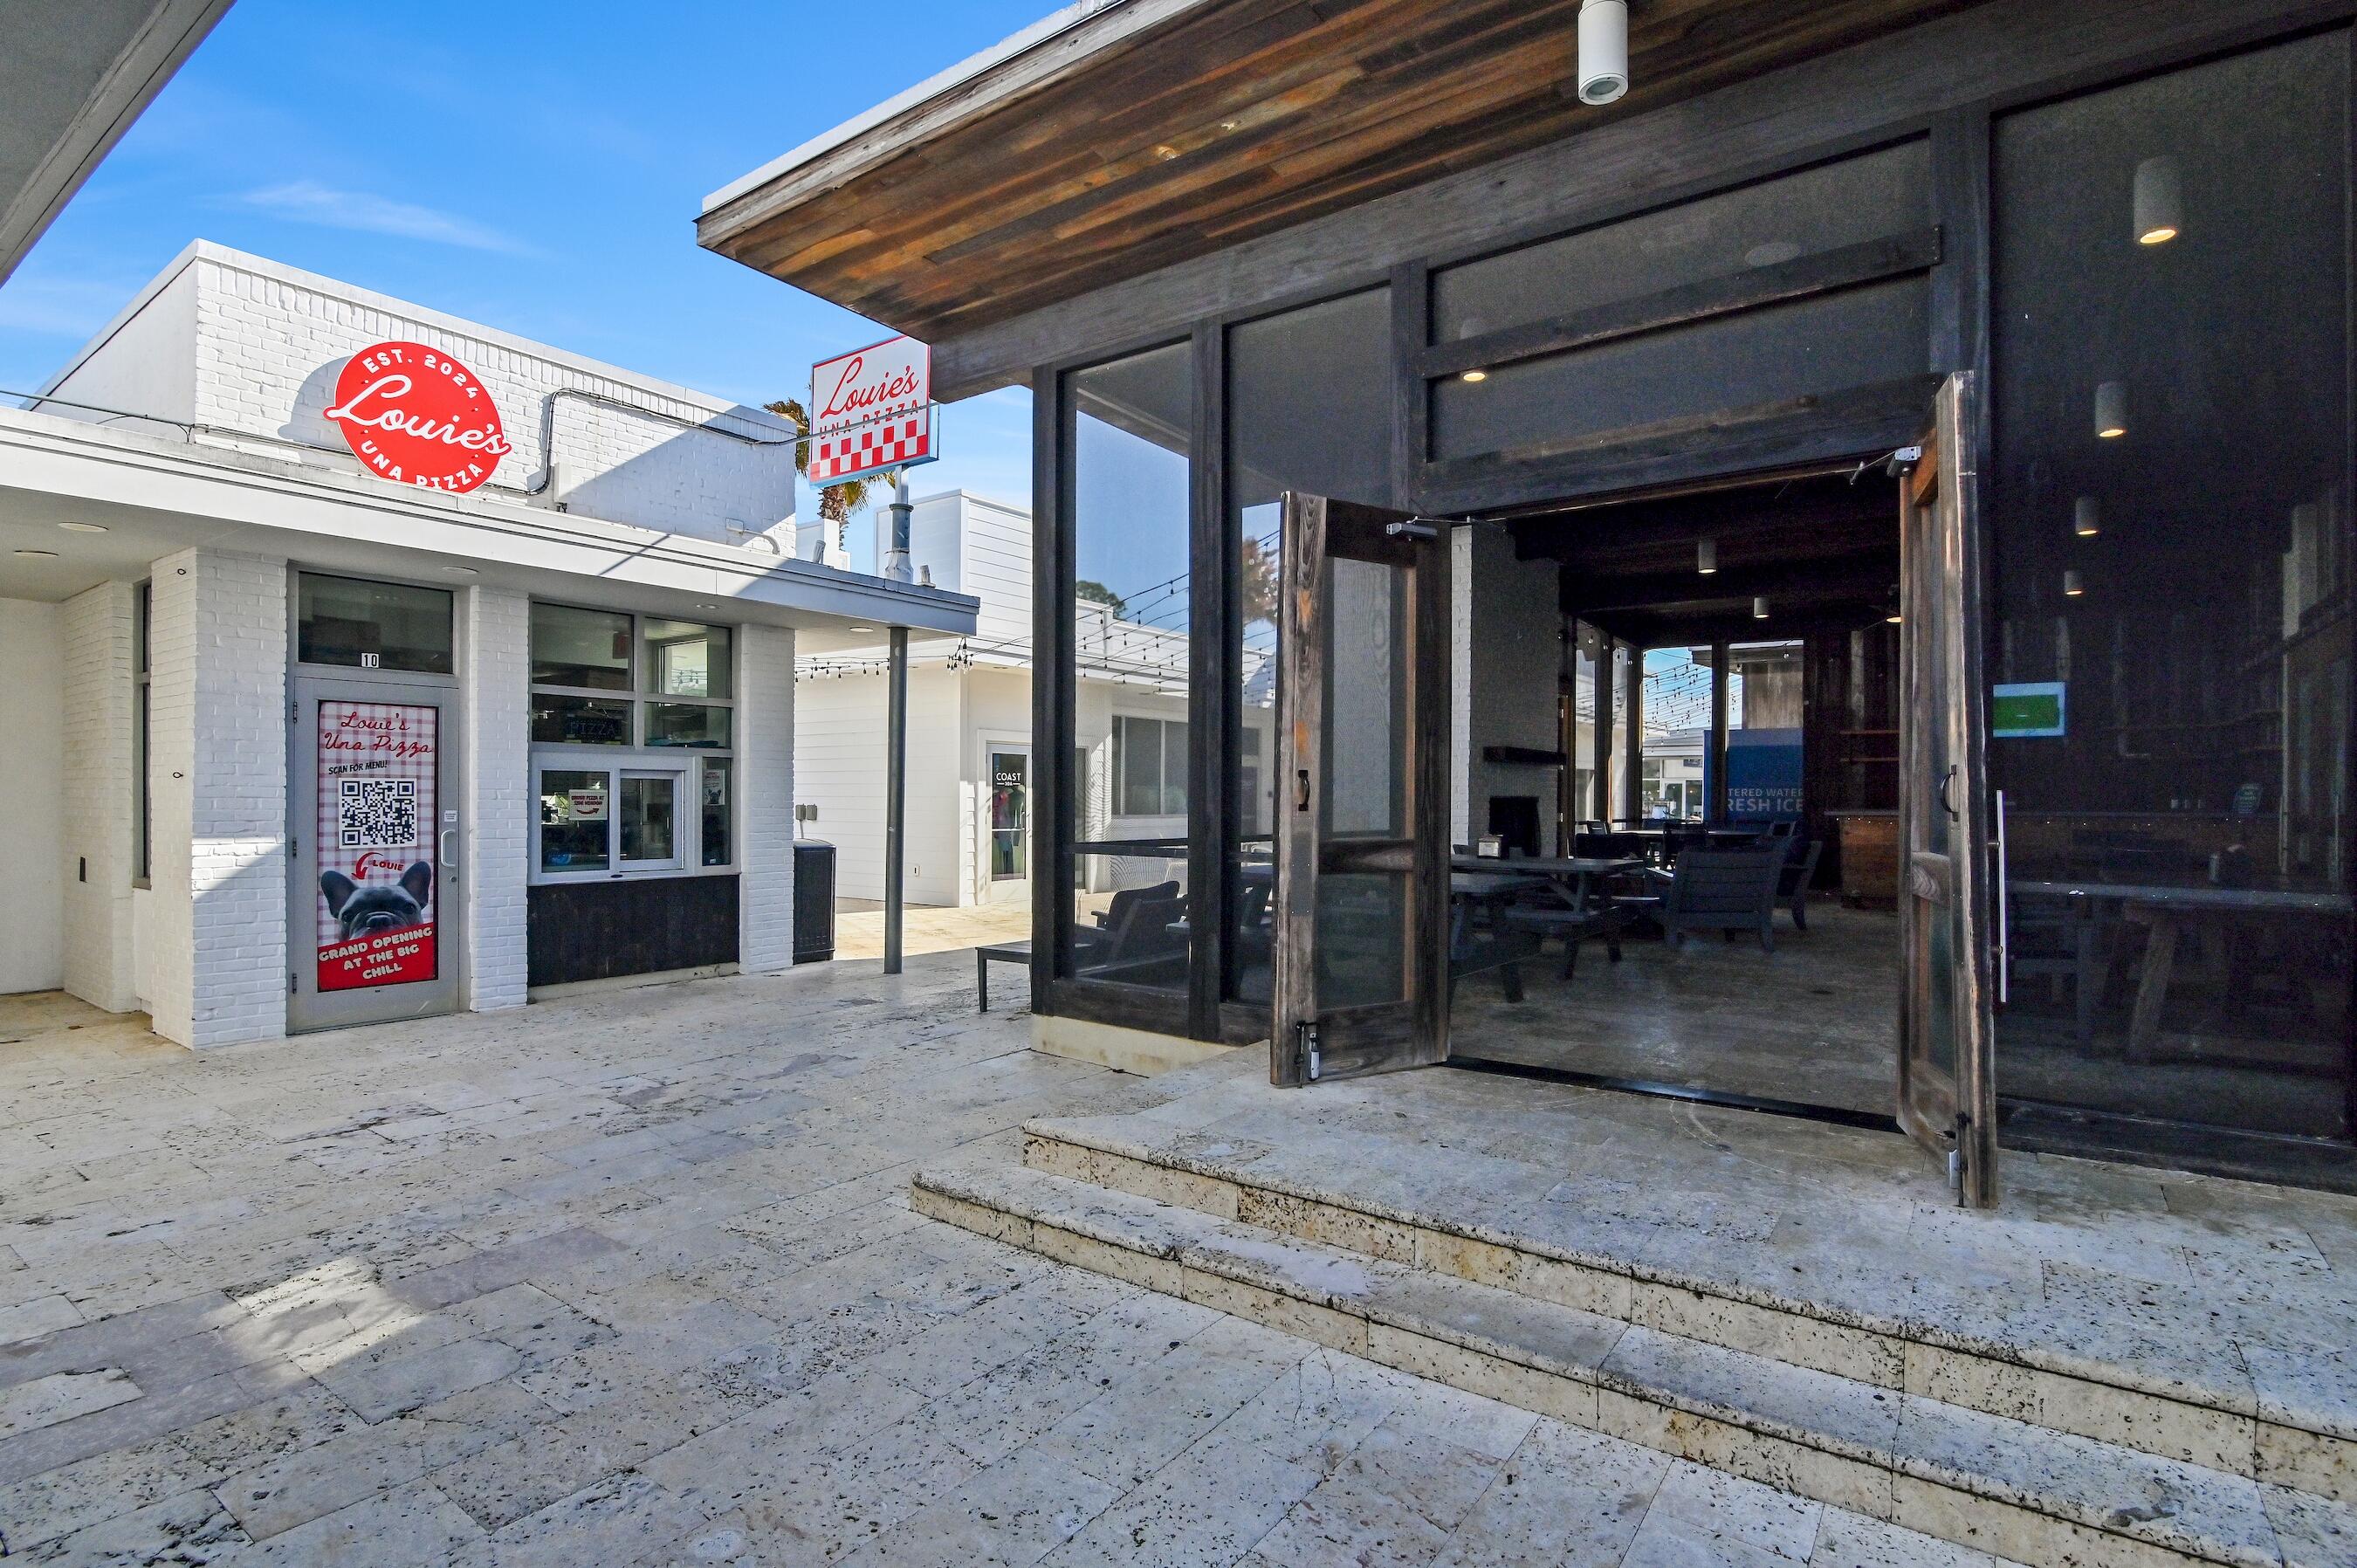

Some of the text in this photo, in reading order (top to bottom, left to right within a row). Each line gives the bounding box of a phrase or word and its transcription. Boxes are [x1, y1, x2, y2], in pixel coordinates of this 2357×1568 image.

[361, 348, 479, 399] EST. 2024
[819, 356, 919, 419] Louie's
[326, 374, 511, 454] Louie's
[819, 399, 918, 440] UNA PIZZA
[361, 439, 484, 490] UNA PIZZA
[364, 654, 378, 667] 10
[340, 711, 410, 731] Louie's
[324, 732, 433, 758] Una Pizza
[328, 760, 388, 775] SCAN FOR MENU!
[996, 772, 1021, 781] COAST
[372, 859, 405, 871] LOUIE
[318, 926, 433, 962] GRAND OPENING
[343, 944, 420, 971] AT THE BIG
[362, 962, 403, 980] CHILL
